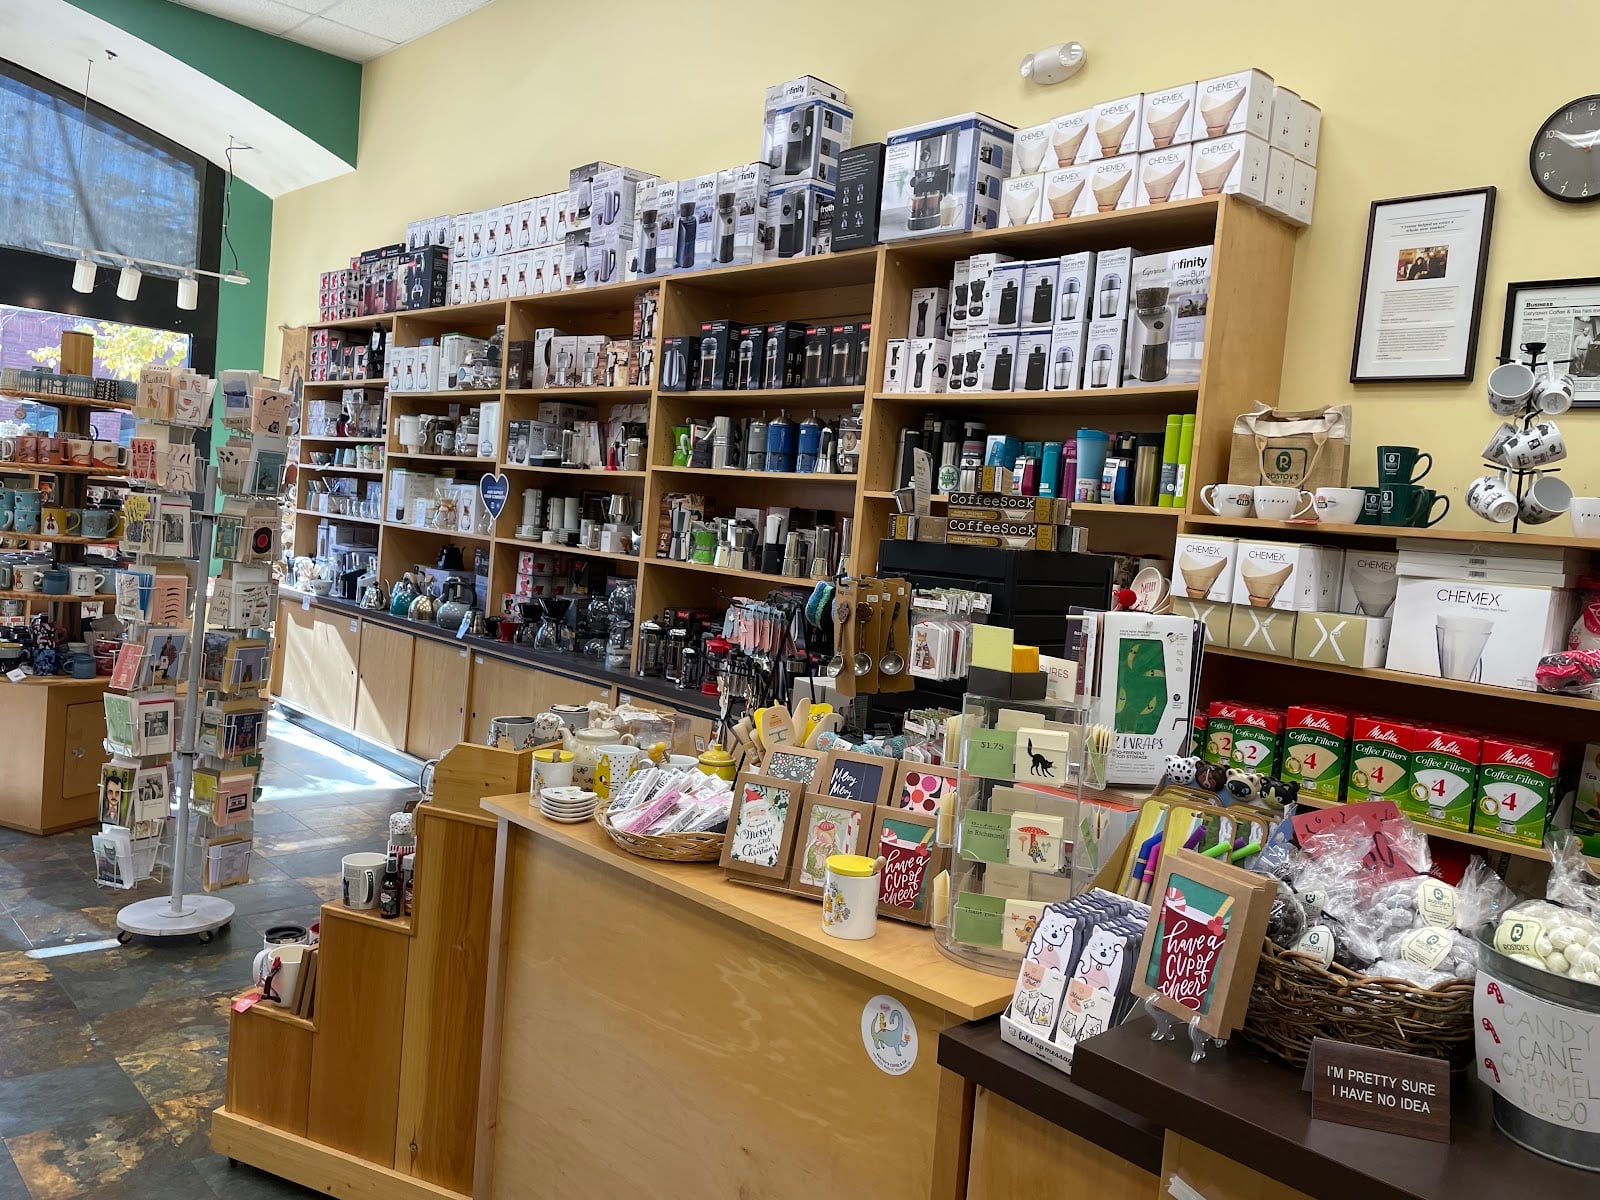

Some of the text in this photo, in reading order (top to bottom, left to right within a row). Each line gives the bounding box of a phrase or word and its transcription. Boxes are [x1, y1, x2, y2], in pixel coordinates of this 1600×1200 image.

[1207, 79, 1240, 93] CHEMEX
[1152, 92, 1183, 106] CHEMEX
[1100, 103, 1129, 116] CHEMEX
[1588, 103, 1596, 111] 12
[1057, 117, 1084, 129] CHEMEX
[1566, 112, 1572, 120] 11
[1020, 130, 1044, 142] CHEMEX
[1546, 130, 1555, 138] 10
[1202, 142, 1234, 155] CHEMEX
[1148, 153, 1180, 166] CHEMEX
[1539, 152, 1546, 160] 9
[1098, 161, 1126, 174] CHEMEX
[1052, 172, 1080, 184] CHEMEX
[1544, 172, 1550, 180] 8
[1009, 181, 1034, 192] CHEMEX
[1560, 186, 1566, 194] 7
[1582, 188, 1588, 196] 6
[1172, 256, 1208, 271] infinity
[1176, 277, 1204, 287] Grinder
[950, 494, 1034, 508] CoffeeSock
[950, 520, 1036, 536] CoffeeSock
[1186, 544, 1220, 556] CHEMEX
[1248, 550, 1286, 561] CHEMEX
[1358, 559, 1397, 570] CHEMEX
[1436, 589, 1502, 607] CHEMEX
[1210, 721, 1228, 730] Coffee
[1243, 714, 1266, 728] Melitta
[1299, 714, 1332, 730] Melitta
[1236, 729, 1273, 741] Coffee Filters
[1288, 732, 1340, 747] Coffee Filters
[1366, 725, 1399, 743] Melitta
[980, 742, 1004, 750] $1.75
[1123, 737, 1164, 750] WRAPS
[1426, 736, 1462, 755] Melitta
[1356, 744, 1407, 760] Coffee Filters
[1496, 748, 1536, 768] Melitta
[1416, 756, 1471, 774] Coffee Filters
[831, 768, 858, 785] Merry
[1484, 768, 1545, 787] Coffee Filters
[1586, 772, 1598, 781] Tea
[829, 782, 852, 799] Merry
[740, 824, 776, 840] Merry
[974, 830, 1005, 840] Richmond
[742, 844, 776, 856] Christmas
[885, 849, 931, 873] have a
[908, 866, 922, 891] of
[880, 887, 919, 910] cheer
[1163, 920, 1226, 953] have a
[1503, 943, 1530, 951] ROSTOV'S
[1195, 951, 1210, 984] of
[1157, 975, 1208, 1011] cheer
[1502, 1002, 1594, 1052] CANDY
[1018, 1032, 1034, 1045] fold
[1035, 1042, 1044, 1050] up
[1045, 1048, 1072, 1066] messag
[1518, 1036, 1584, 1074] CANE
[1327, 1065, 1436, 1096] I'M PRETTY SURE
[1502, 1052, 1600, 1100] CARAMEL
[1340, 1086, 1373, 1103] HAVE
[1378, 1093, 1396, 1107] NO
[1400, 1097, 1431, 1114] IDEA
[1522, 1088, 1587, 1124] $6.50
